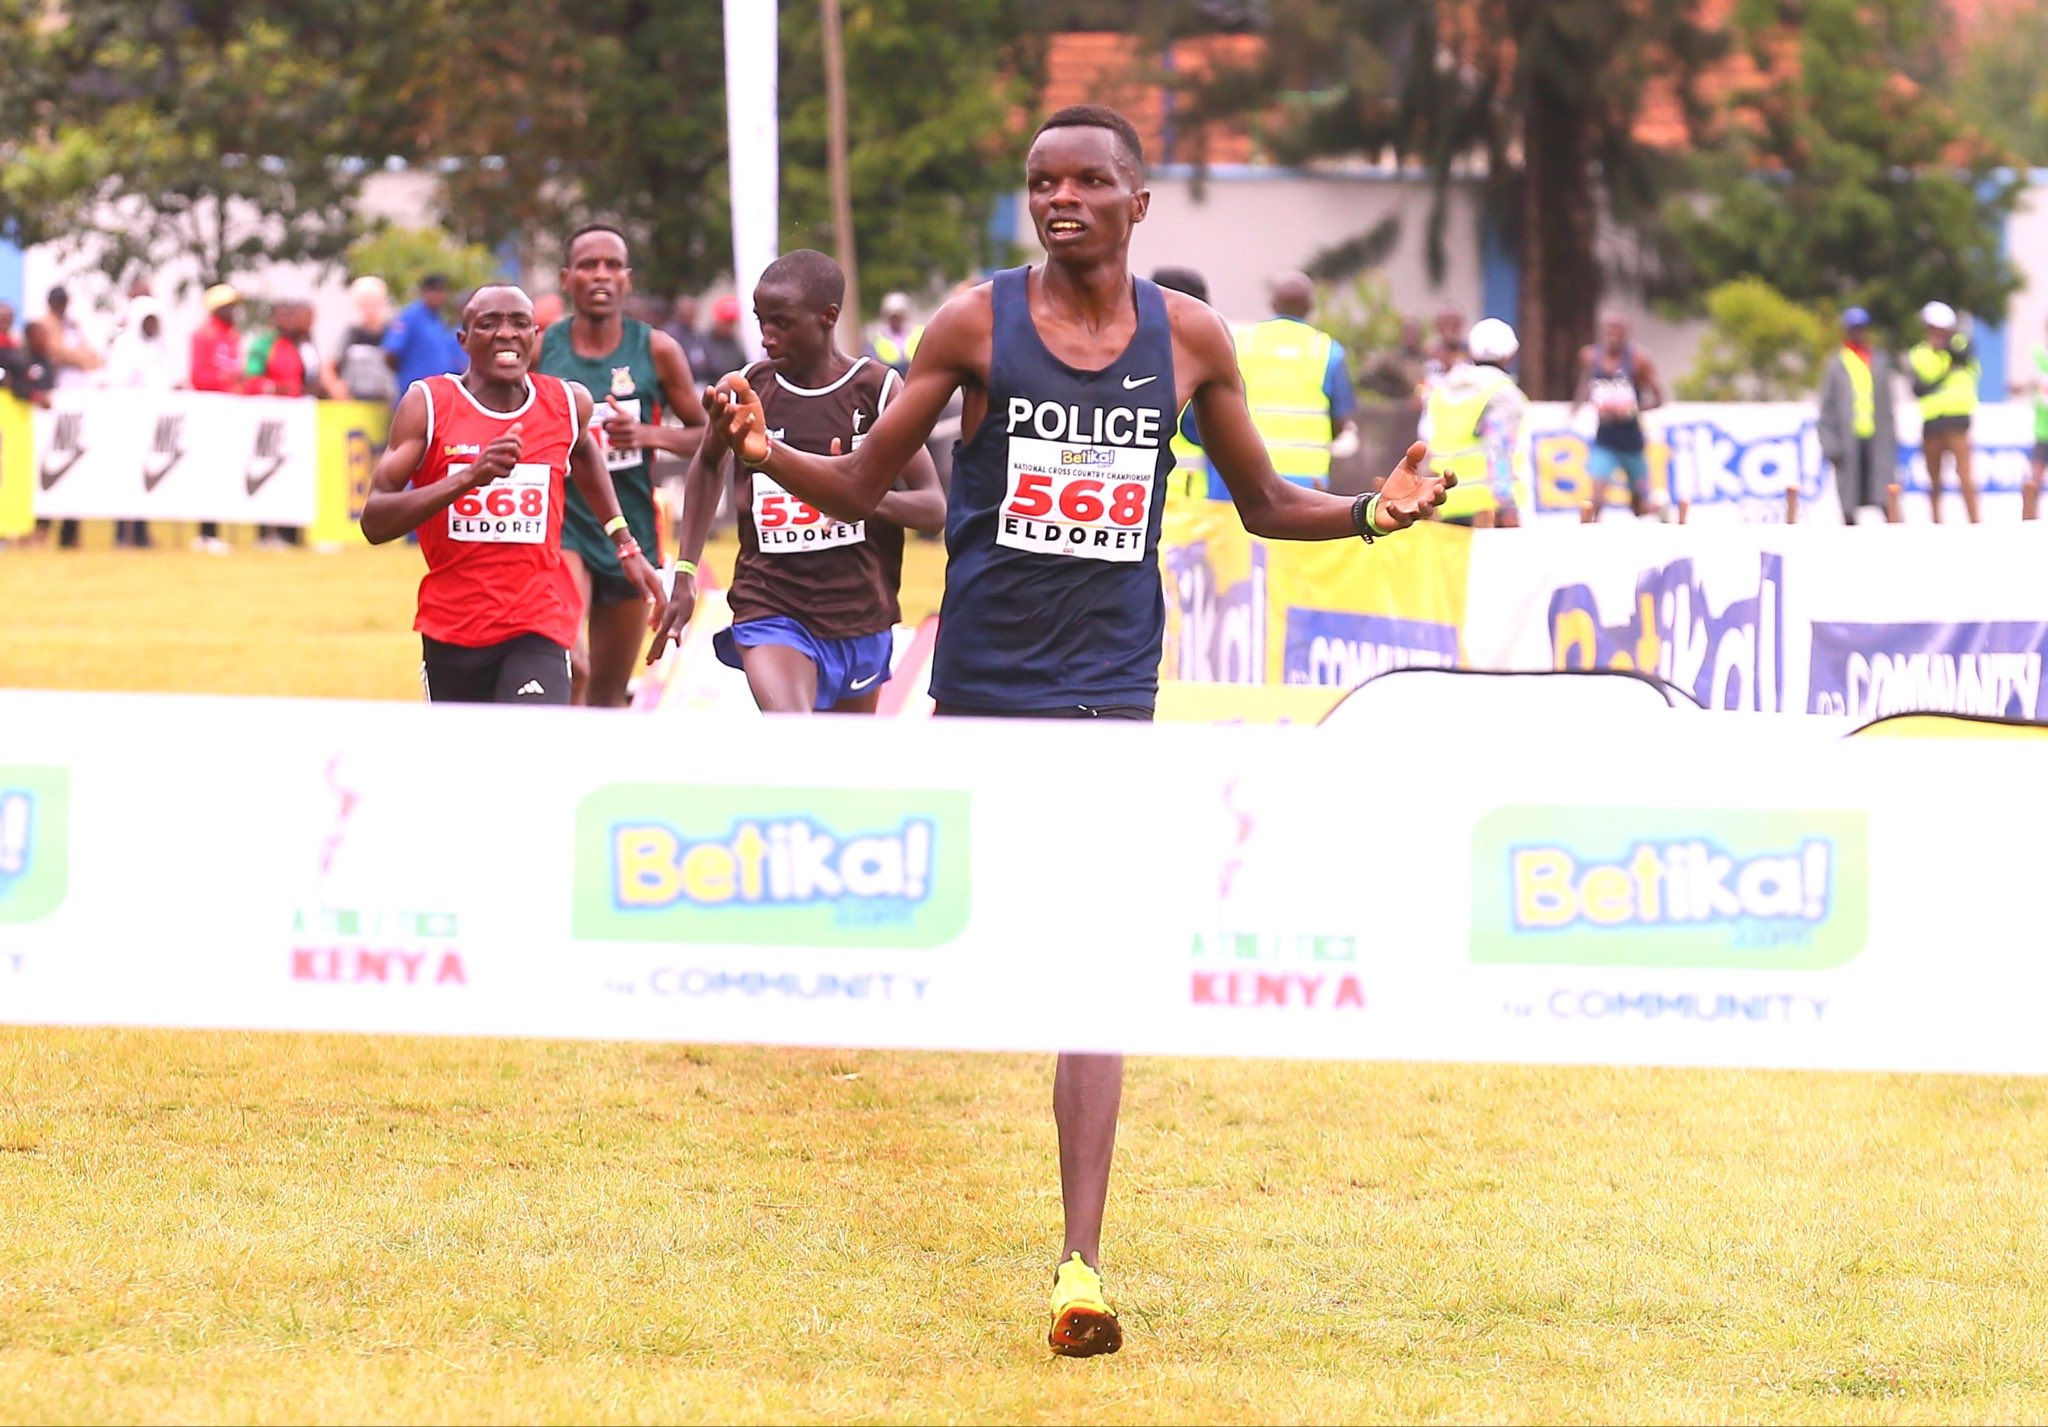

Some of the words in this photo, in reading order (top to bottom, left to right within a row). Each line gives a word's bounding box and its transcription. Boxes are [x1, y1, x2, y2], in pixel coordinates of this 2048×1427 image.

[1006, 397, 1161, 447] POLICE
[1014, 462, 1046, 474] NATIONAL
[1048, 466, 1071, 476] CROSS
[1073, 469, 1105, 479] COUNTRY
[1061, 449, 1115, 465] Betika!
[453, 487, 543, 517] 668
[761, 496, 821, 527] 53
[1007, 472, 1147, 526] 568
[452, 520, 542, 534] ELDORET
[762, 524, 861, 544] ELDORET
[1004, 517, 1142, 550] ELDORET
[613, 818, 934, 907] Betika!
[1512, 839, 1831, 931] Betika!
[290, 946, 467, 986] KENYA
[1190, 970, 1366, 1011] KENYA
